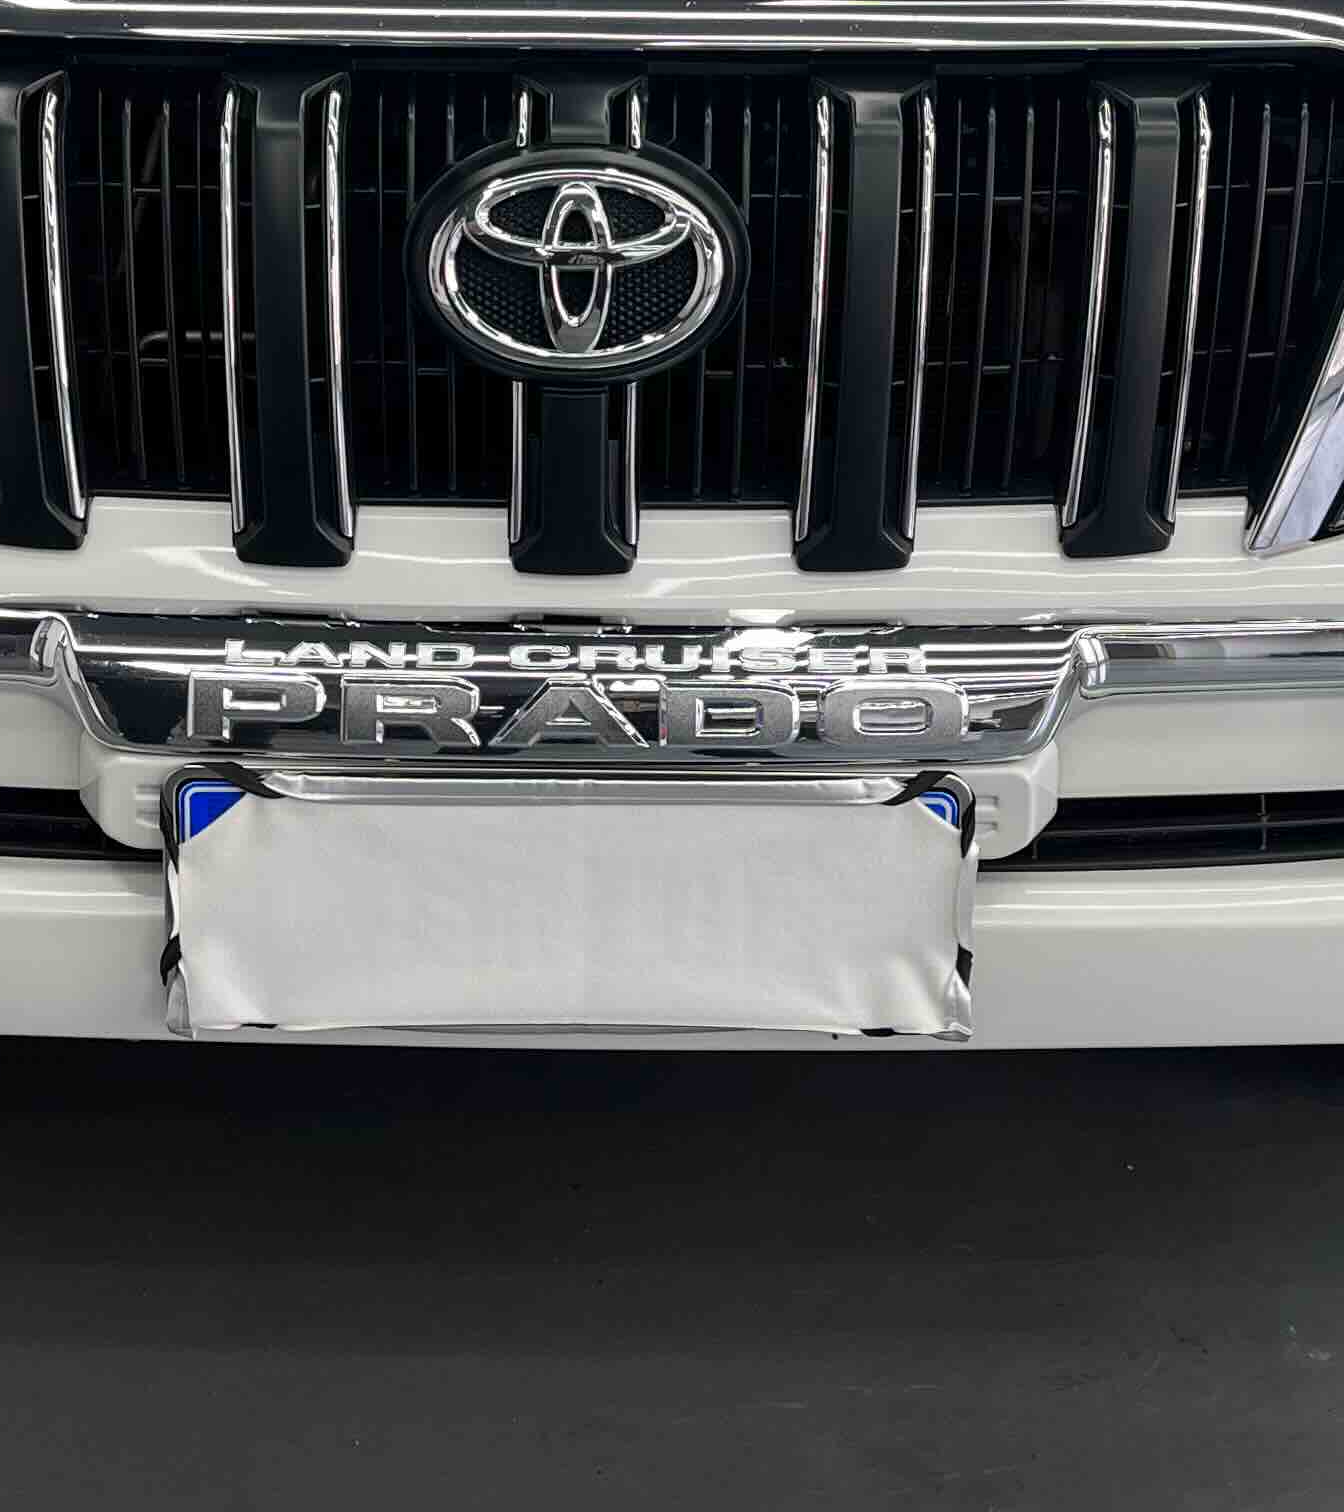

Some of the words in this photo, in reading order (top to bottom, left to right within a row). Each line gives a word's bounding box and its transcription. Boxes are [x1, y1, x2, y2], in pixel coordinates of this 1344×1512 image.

[223, 637, 476, 669] LAND
[508, 643, 928, 675] CRUISER
[186, 668, 970, 749] PRADO
